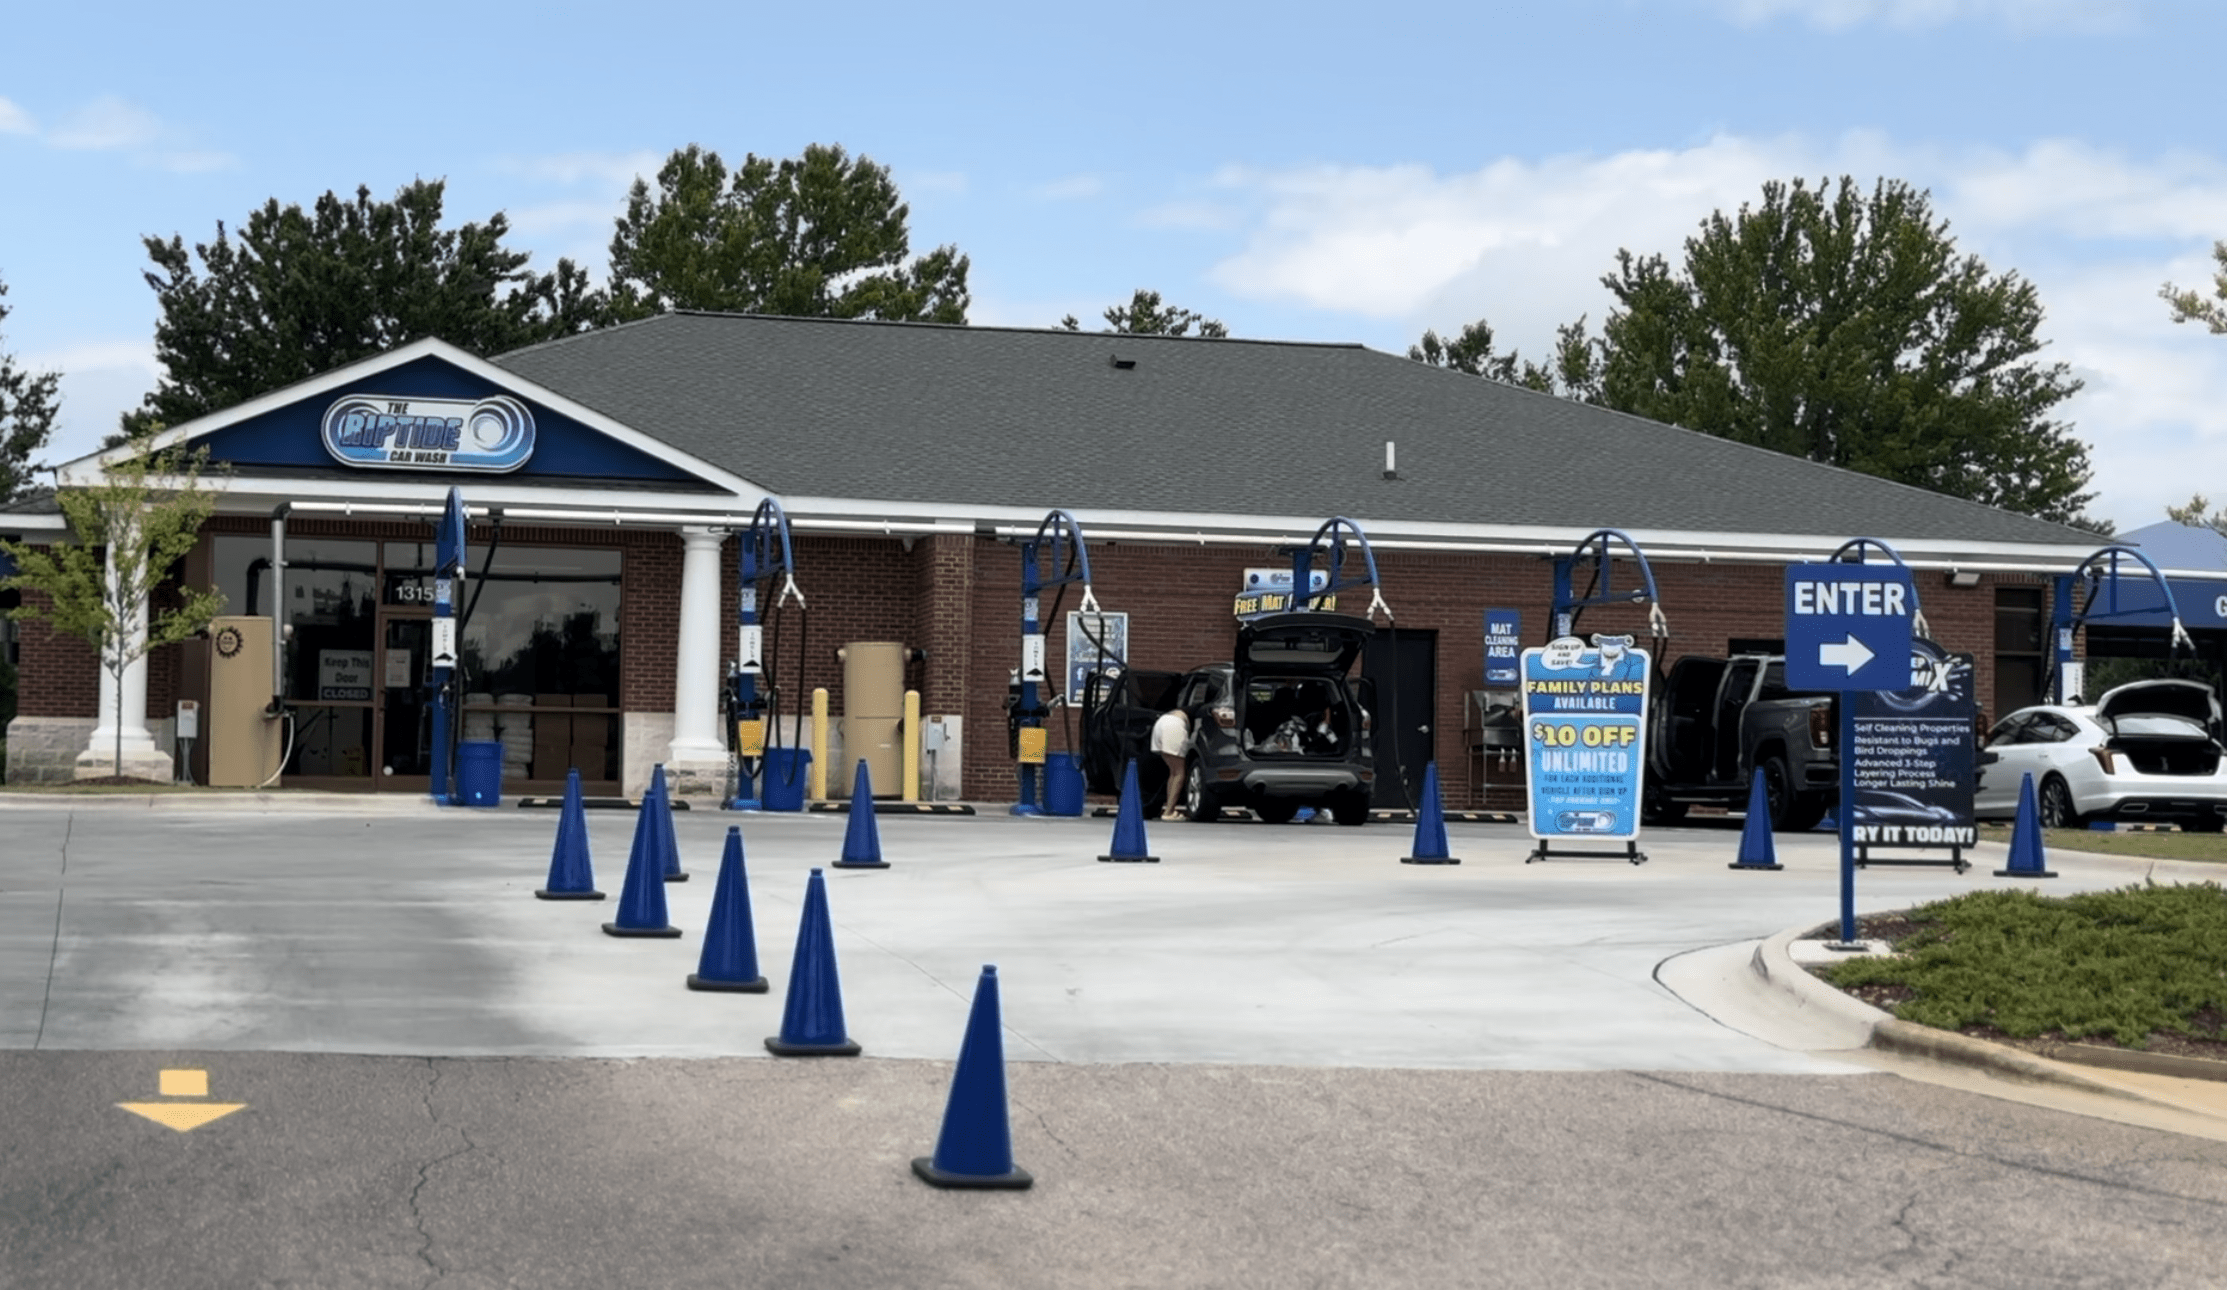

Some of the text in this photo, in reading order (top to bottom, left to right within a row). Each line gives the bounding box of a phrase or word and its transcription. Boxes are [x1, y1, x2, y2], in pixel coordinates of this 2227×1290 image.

[387, 402, 408, 414] THE
[339, 412, 464, 451] RIPTIDE
[389, 450, 448, 464] CAR WASH
[395, 585, 434, 601] 1315
[1794, 581, 1906, 615] ENTER
[1233, 597, 1258, 615] FREE
[1261, 594, 1285, 611] MAT
[1491, 623, 1512, 635] MAT
[1484, 634, 1519, 646] CLEANING
[1487, 646, 1516, 658] AREA
[325, 657, 370, 669] Keep This
[335, 672, 358, 683] Door
[323, 688, 369, 699] CLOSED
[1526, 681, 1643, 694] FAMILY PLANS
[1554, 697, 1616, 709] AVAILABLE
[1854, 723, 1970, 734] Self Cleaning Properties
[1533, 724, 1636, 746] $10 OFF
[1854, 736, 1960, 746] Resistant to Bugs and
[1854, 746, 1928, 757] Bird Droppings
[1541, 751, 1628, 773] UNLIMITED
[1854, 758, 1936, 769] Advanced 3-Step
[1853, 769, 1936, 779] Layering Process
[1853, 779, 1956, 789] Longer Lasting Shine
[1853, 825, 1975, 843] RY IT TODAY!
